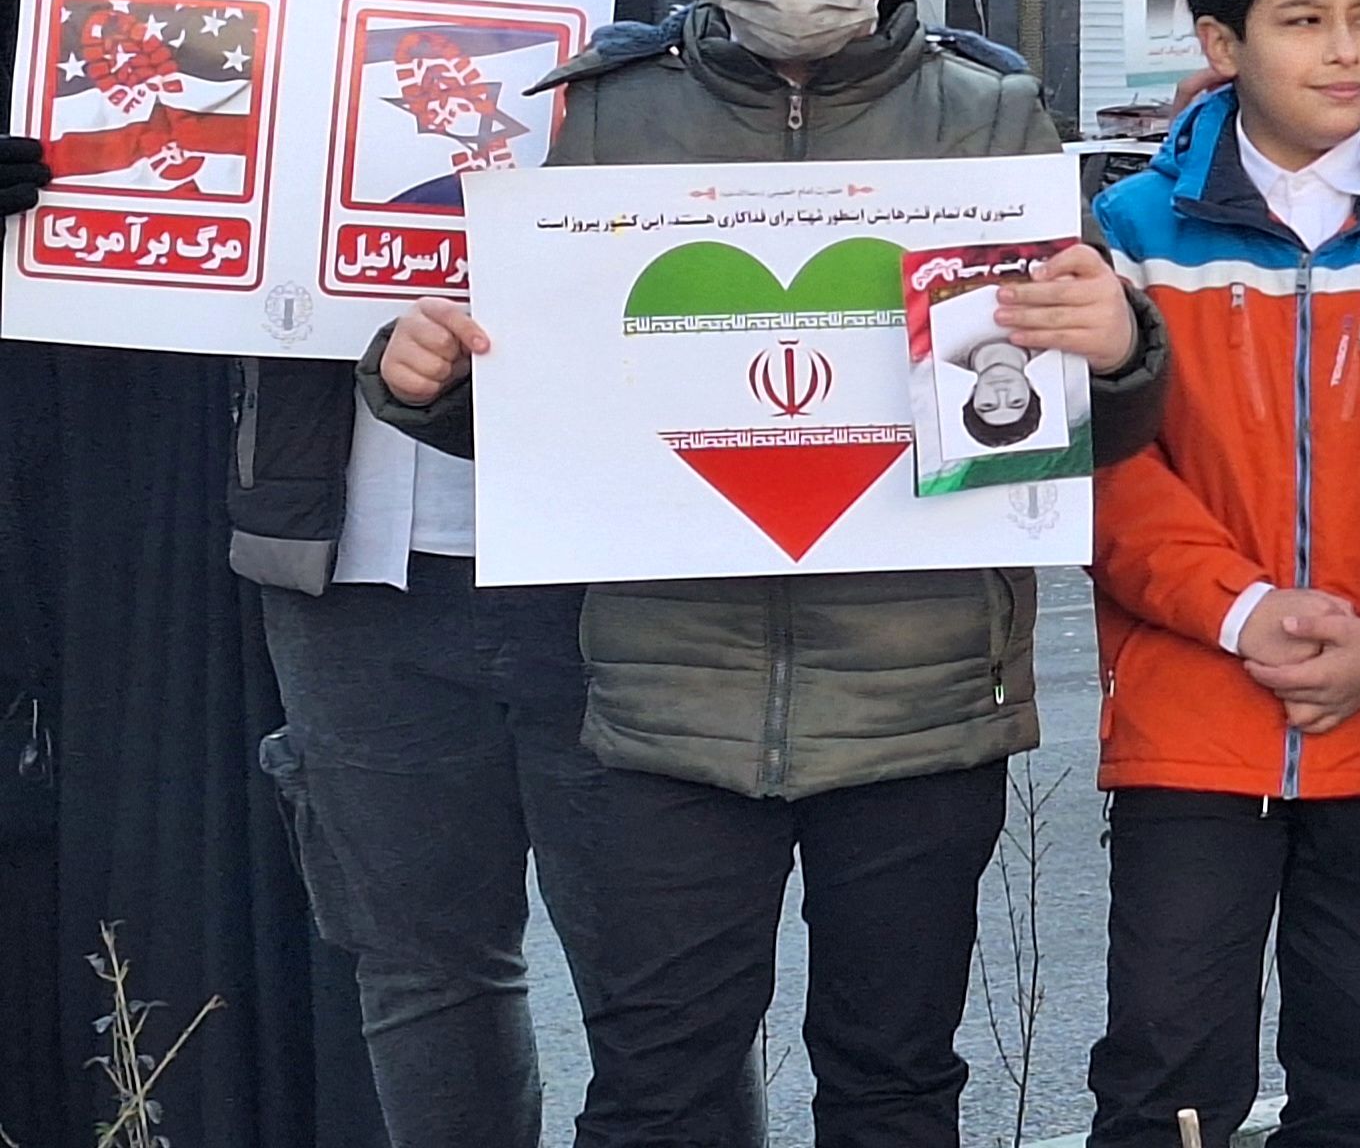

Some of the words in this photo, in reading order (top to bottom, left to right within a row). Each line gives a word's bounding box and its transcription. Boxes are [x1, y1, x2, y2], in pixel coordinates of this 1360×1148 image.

[42, 215, 149, 263] آمریکا
[145, 232, 172, 265] بر
[178, 226, 242, 269] مرگ
[337, 232, 449, 280] اسرائیل
